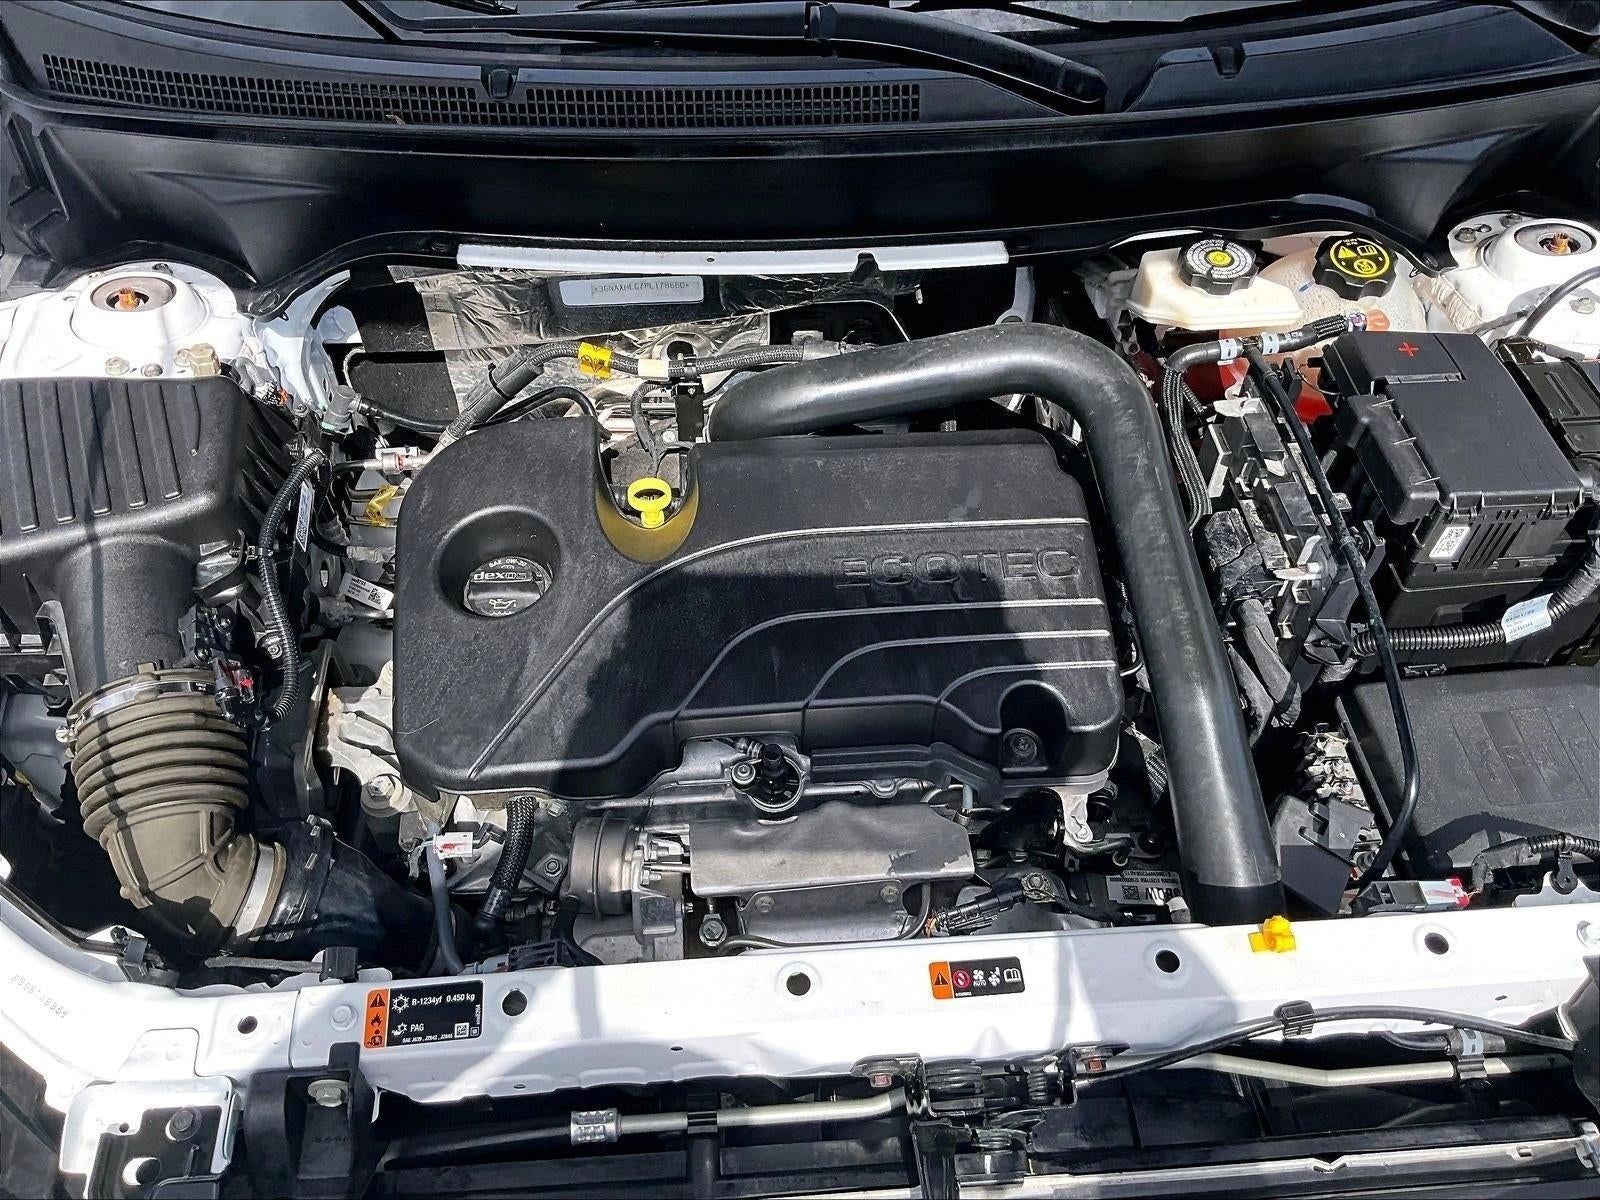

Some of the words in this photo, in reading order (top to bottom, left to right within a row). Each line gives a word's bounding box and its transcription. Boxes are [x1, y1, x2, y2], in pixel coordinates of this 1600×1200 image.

[488, 559, 502, 568] SAE
[833, 549, 1080, 588] ECOTEC
[473, 571, 527, 580] dexos
[411, 996, 443, 1006] R-1234yf
[446, 993, 465, 1003] 0.450
[466, 992, 476, 1002] kg
[410, 1023, 425, 1032] PAG
